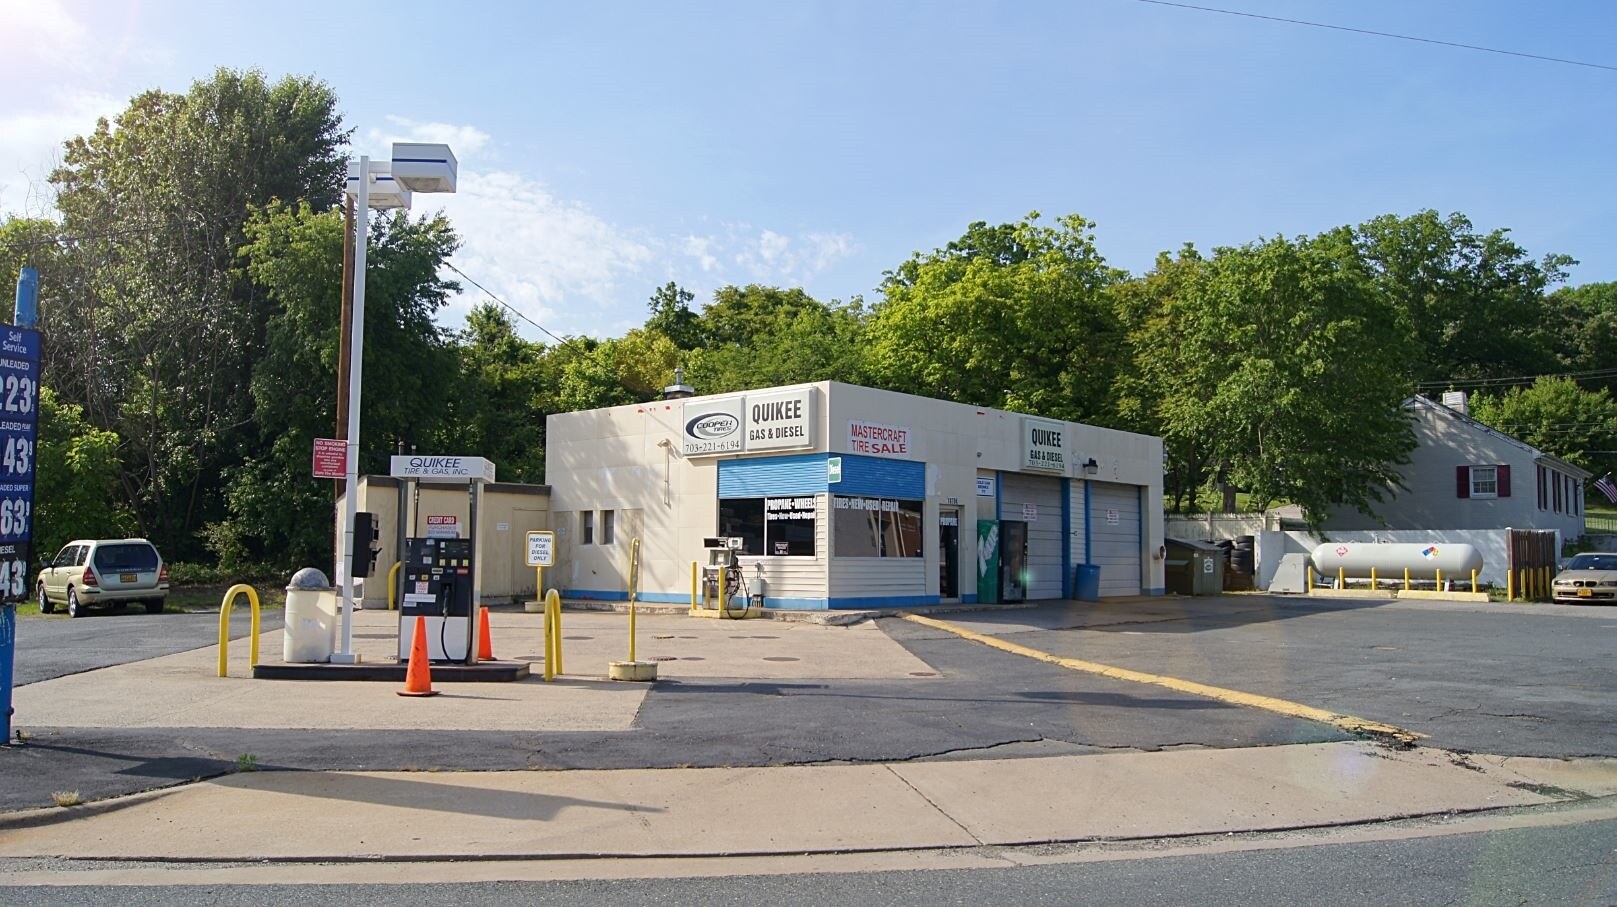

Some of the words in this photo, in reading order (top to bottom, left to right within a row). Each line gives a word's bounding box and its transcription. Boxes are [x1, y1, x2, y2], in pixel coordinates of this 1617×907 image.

[9, 331, 22, 342] Self
[2, 340, 27, 354] Service
[753, 400, 801, 424] QUIKEE
[697, 420, 732, 429] COOPER
[750, 429, 765, 440] GAS
[768, 428, 773, 438] &
[776, 425, 804, 438] DIESEL
[851, 424, 906, 442] MASTERCRAFT
[1032, 428, 1061, 448] QUIKEE
[685, 440, 739, 452] 703-221-6194
[852, 440, 869, 453] TIRE
[871, 443, 907, 453] SALE
[1030, 450, 1041, 460] GAS
[1047, 452, 1063, 462] DIESEL
[410, 457, 461, 468] QUIKEE
[14, 484, 29, 492] SUPER
[767, 499, 792, 510] PROPANE
[428, 516, 443, 524] CREDIT
[444, 516, 455, 524] CARD
